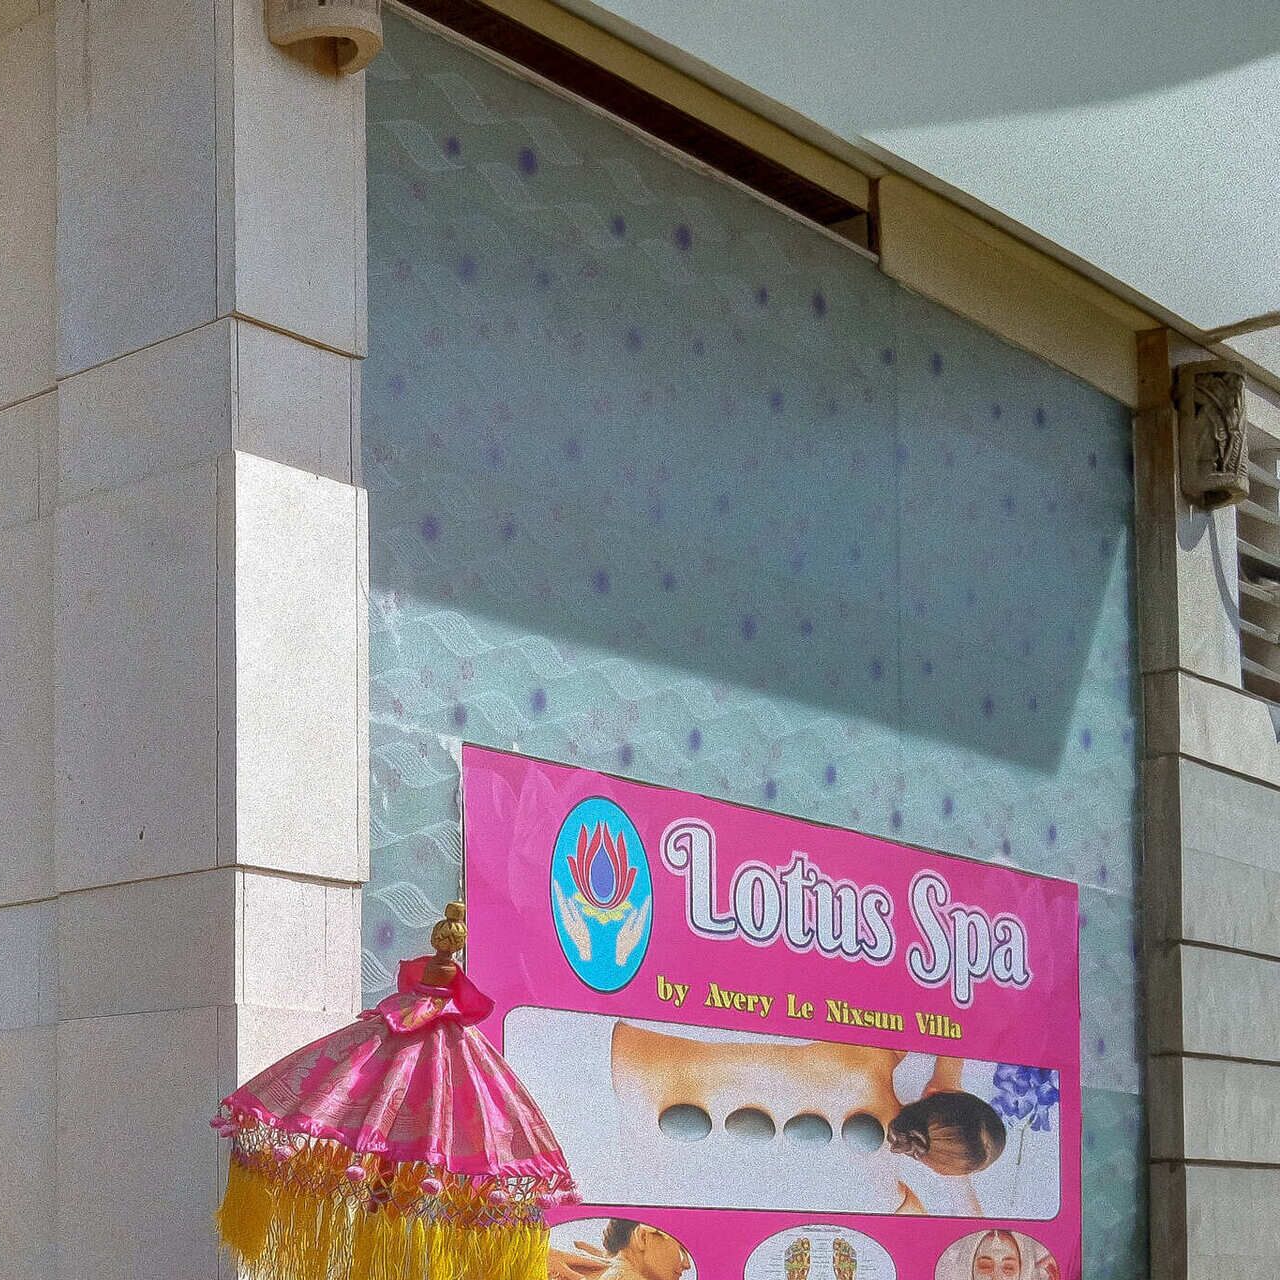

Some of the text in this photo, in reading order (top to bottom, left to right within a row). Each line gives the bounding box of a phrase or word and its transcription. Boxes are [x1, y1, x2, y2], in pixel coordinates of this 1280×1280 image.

[663, 823, 1032, 1003] Lotus Spa
[656, 975, 962, 1039] by Avery Le Nixsun Villa
